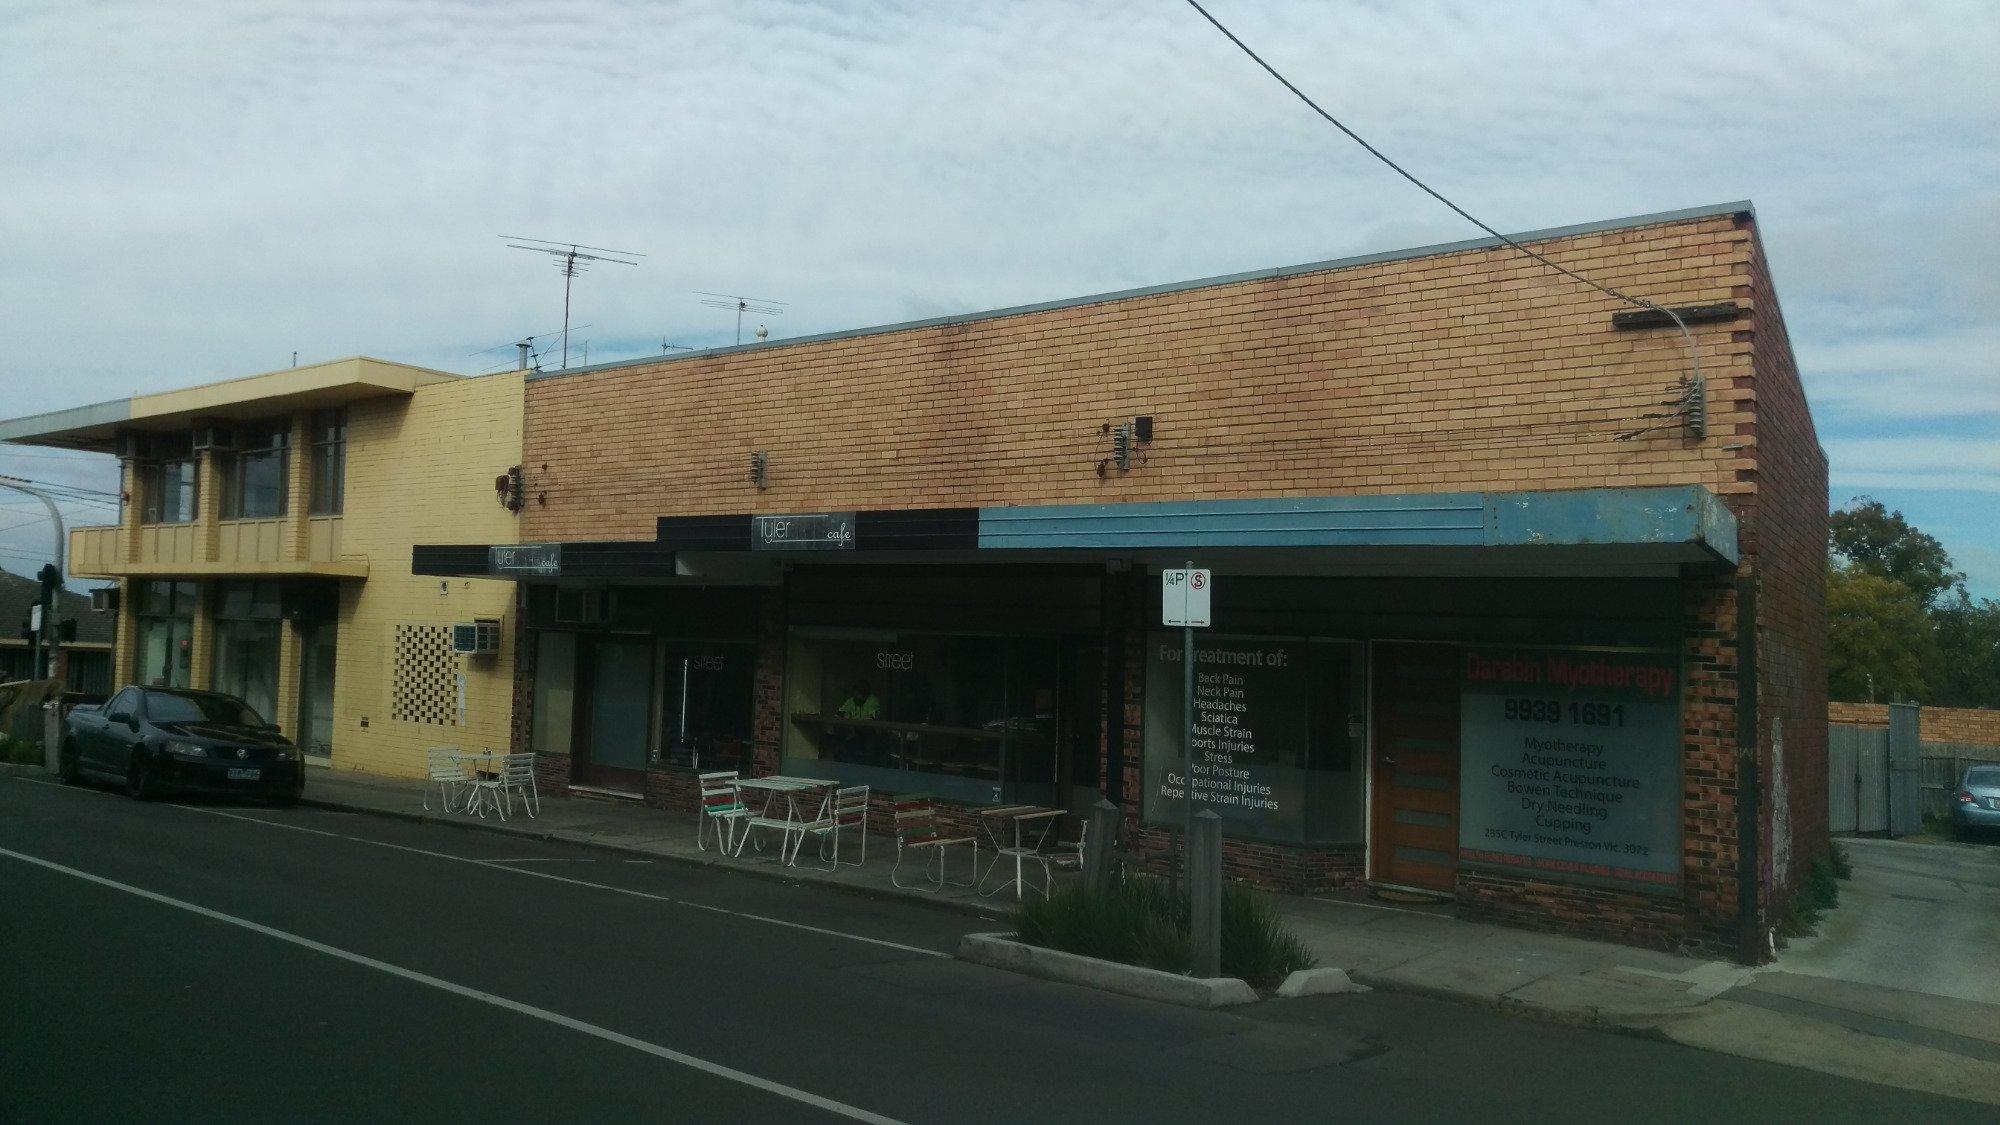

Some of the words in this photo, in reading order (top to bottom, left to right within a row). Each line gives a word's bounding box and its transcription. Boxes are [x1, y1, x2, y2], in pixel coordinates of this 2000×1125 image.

[757, 515, 791, 544] Tyler
[827, 521, 852, 546] cafe
[541, 553, 559, 574] cafe
[1159, 645, 1184, 662] For
[1189, 647, 1263, 666] reatment
[1266, 648, 1288, 667] of:
[1198, 673, 1221, 684] Back
[1223, 674, 1244, 685] Pain
[1546, 655, 1674, 697] Myotherapy
[1197, 685, 1221, 698] Neck
[1223, 686, 1244, 699] Pain
[1193, 698, 1247, 713] Headaches
[1568, 702, 1625, 727] 1691
[1201, 711, 1238, 725] Sciatica
[1223, 726, 1253, 740] Strain
[1191, 739, 1216, 750] ports
[1218, 739, 1255, 754] Injuries
[1525, 736, 1604, 756] Myotherapy
[1204, 751, 1233, 765] Stress
[1522, 752, 1607, 770] Acupuncture
[1191, 763, 1211, 775] oor
[1212, 765, 1250, 780] Posture
[1491, 764, 1550, 782] Cosmetic
[1553, 769, 1640, 790] Acupuncture
[1168, 772, 1231, 791] Occpational
[1233, 779, 1271, 797] Injuries
[1507, 780, 1550, 796] Bowen
[1554, 784, 1624, 804] Technique
[1160, 785, 1208, 801] Repetive
[1210, 790, 1239, 805] Strain
[1241, 794, 1279, 811] Injuries
[1521, 797, 1543, 813] Dry
[1547, 800, 1608, 821] Needling
[1535, 813, 1592, 835] Cupping
[1509, 830, 1532, 844] Tyler
[1534, 833, 1562, 846] Street
